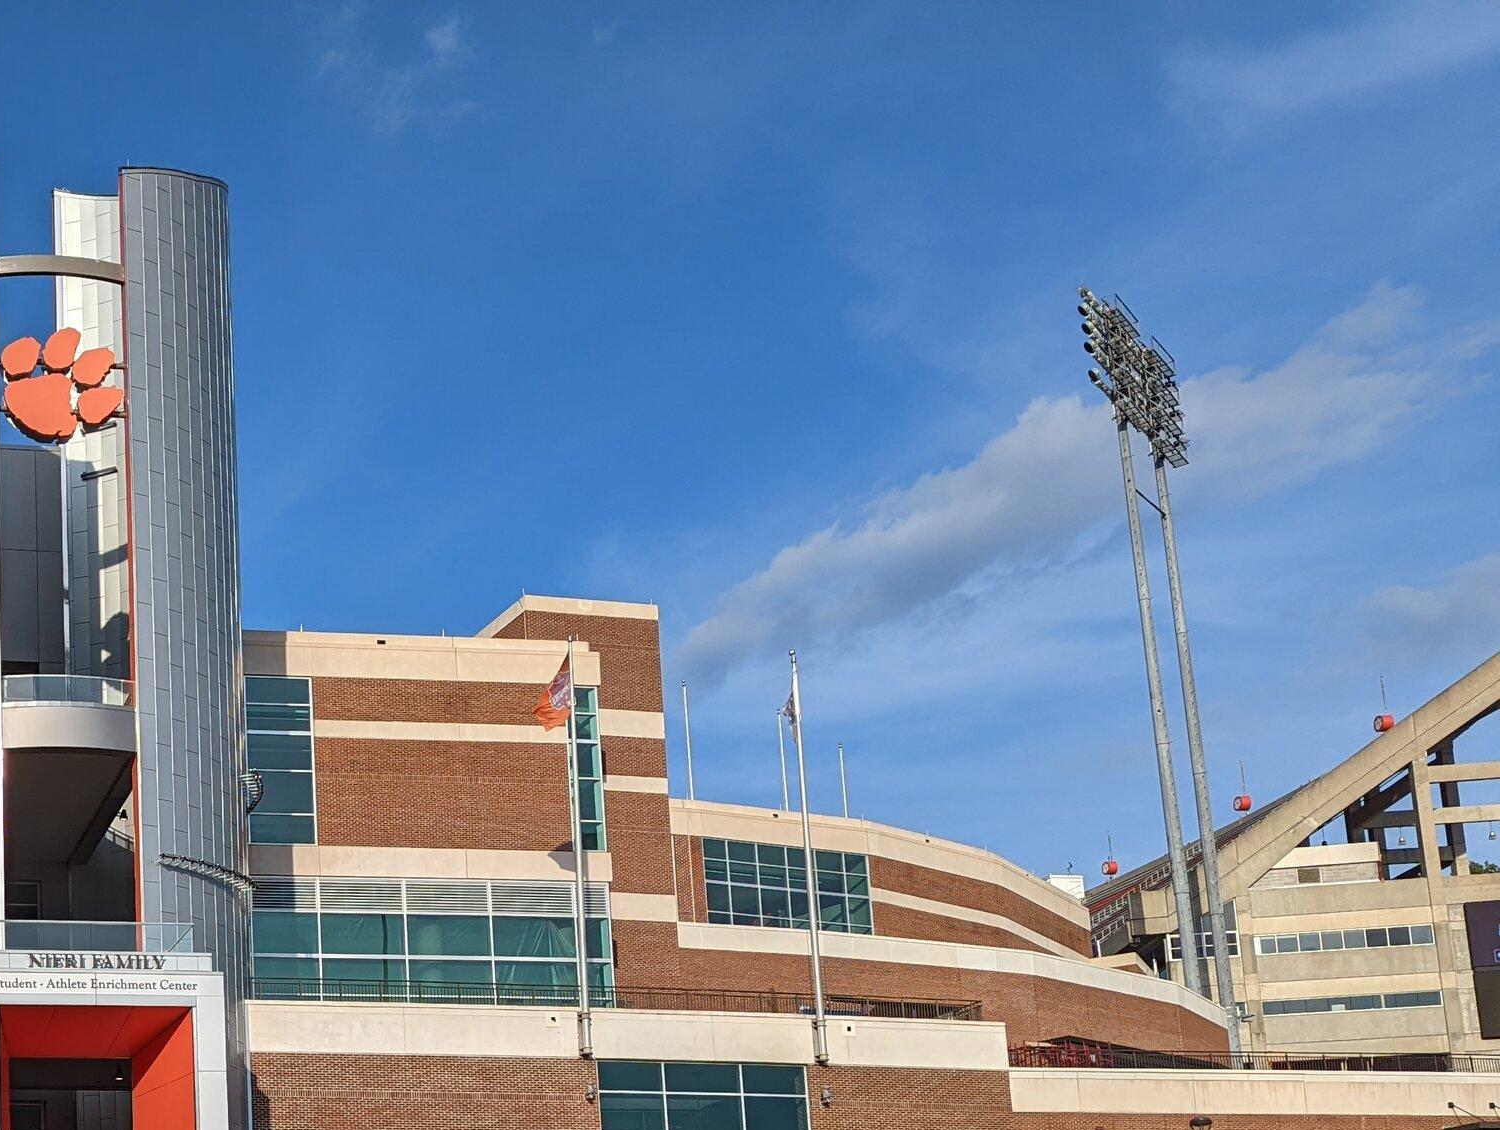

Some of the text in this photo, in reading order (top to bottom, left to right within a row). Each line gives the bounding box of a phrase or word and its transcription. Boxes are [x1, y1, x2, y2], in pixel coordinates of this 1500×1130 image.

[28, 953, 166, 970] NIERI FAMILY
[46, 978, 88, 989] Athlete
[90, 979, 157, 990] Enrichment
[159, 979, 199, 991] Center
